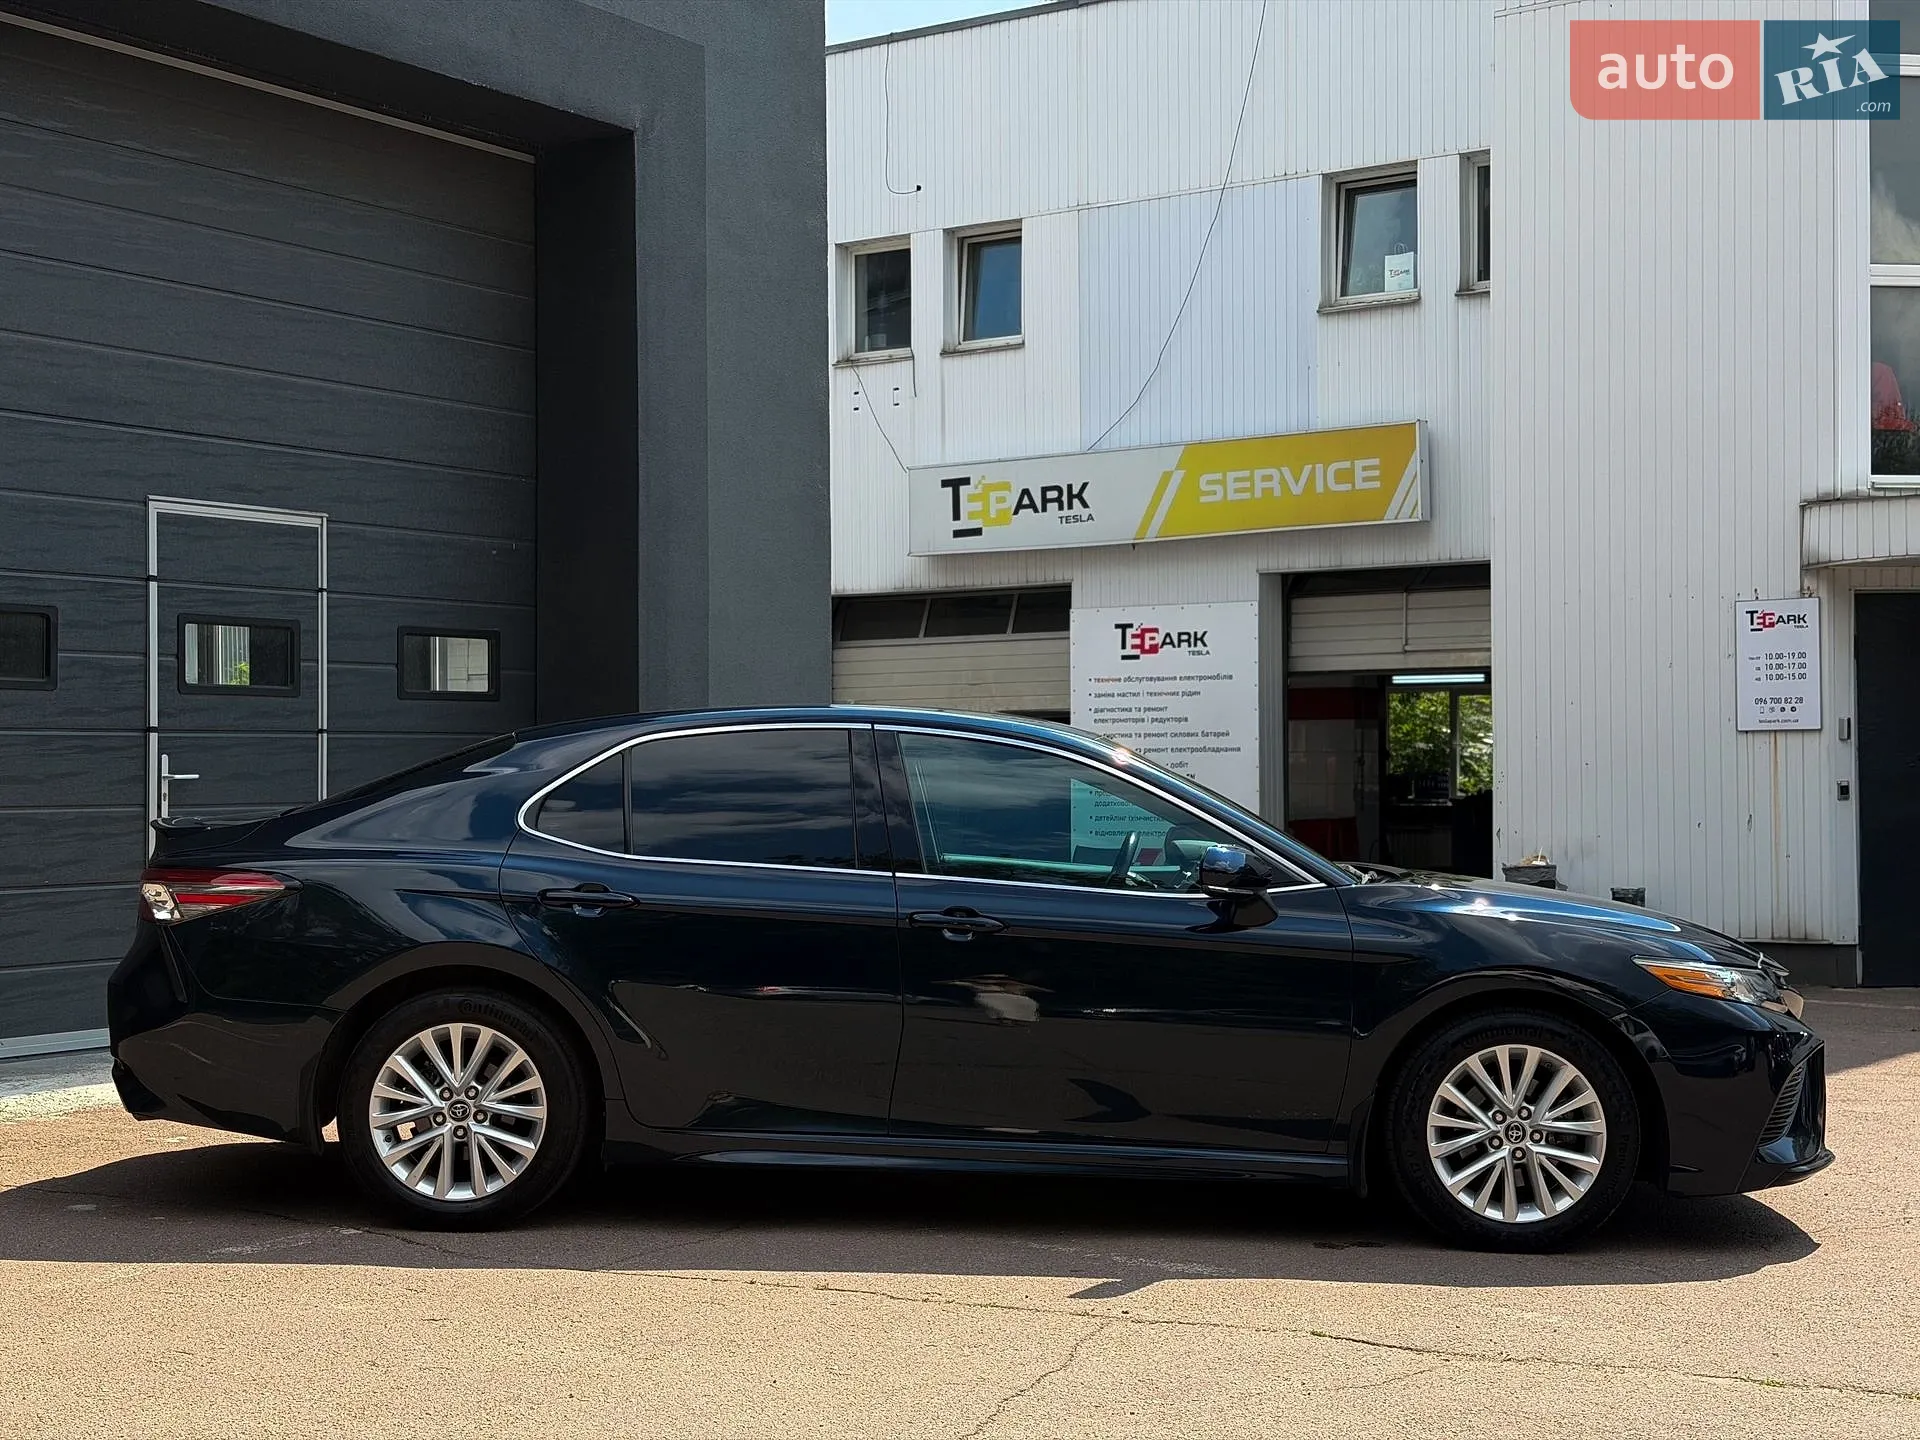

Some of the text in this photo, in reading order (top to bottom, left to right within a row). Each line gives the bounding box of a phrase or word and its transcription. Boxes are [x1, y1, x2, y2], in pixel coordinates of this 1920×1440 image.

[1199, 458, 1381, 504] SERVICE
[1058, 512, 1095, 525] TESLA
[1764, 652, 1807, 660] 10.00-19.00
[1764, 662, 1807, 671] 10.00-17.00
[1093, 673, 1234, 684] технічне обслуговування електромобілів
[1764, 672, 1807, 681] 10.00-15.00
[1116, 690, 1141, 698] мастил
[1146, 690, 1180, 698] технічних
[1181, 689, 1201, 699] рідин
[1754, 697, 1768, 705] 096
[1769, 697, 1783, 705] 700
[1794, 696, 1804, 704] 28
[1093, 705, 1133, 714] діагностика
[1143, 705, 1169, 714] ремонт
[1093, 716, 1145, 724] електромоторів
[1150, 715, 1189, 725] редукторів
[1143, 731, 1169, 740] ремонт
[1170, 731, 1199, 739] силових
[1201, 729, 1230, 739] батарей
[1143, 746, 1169, 755] ремонт
[1170, 745, 1242, 754] електрообладнання
